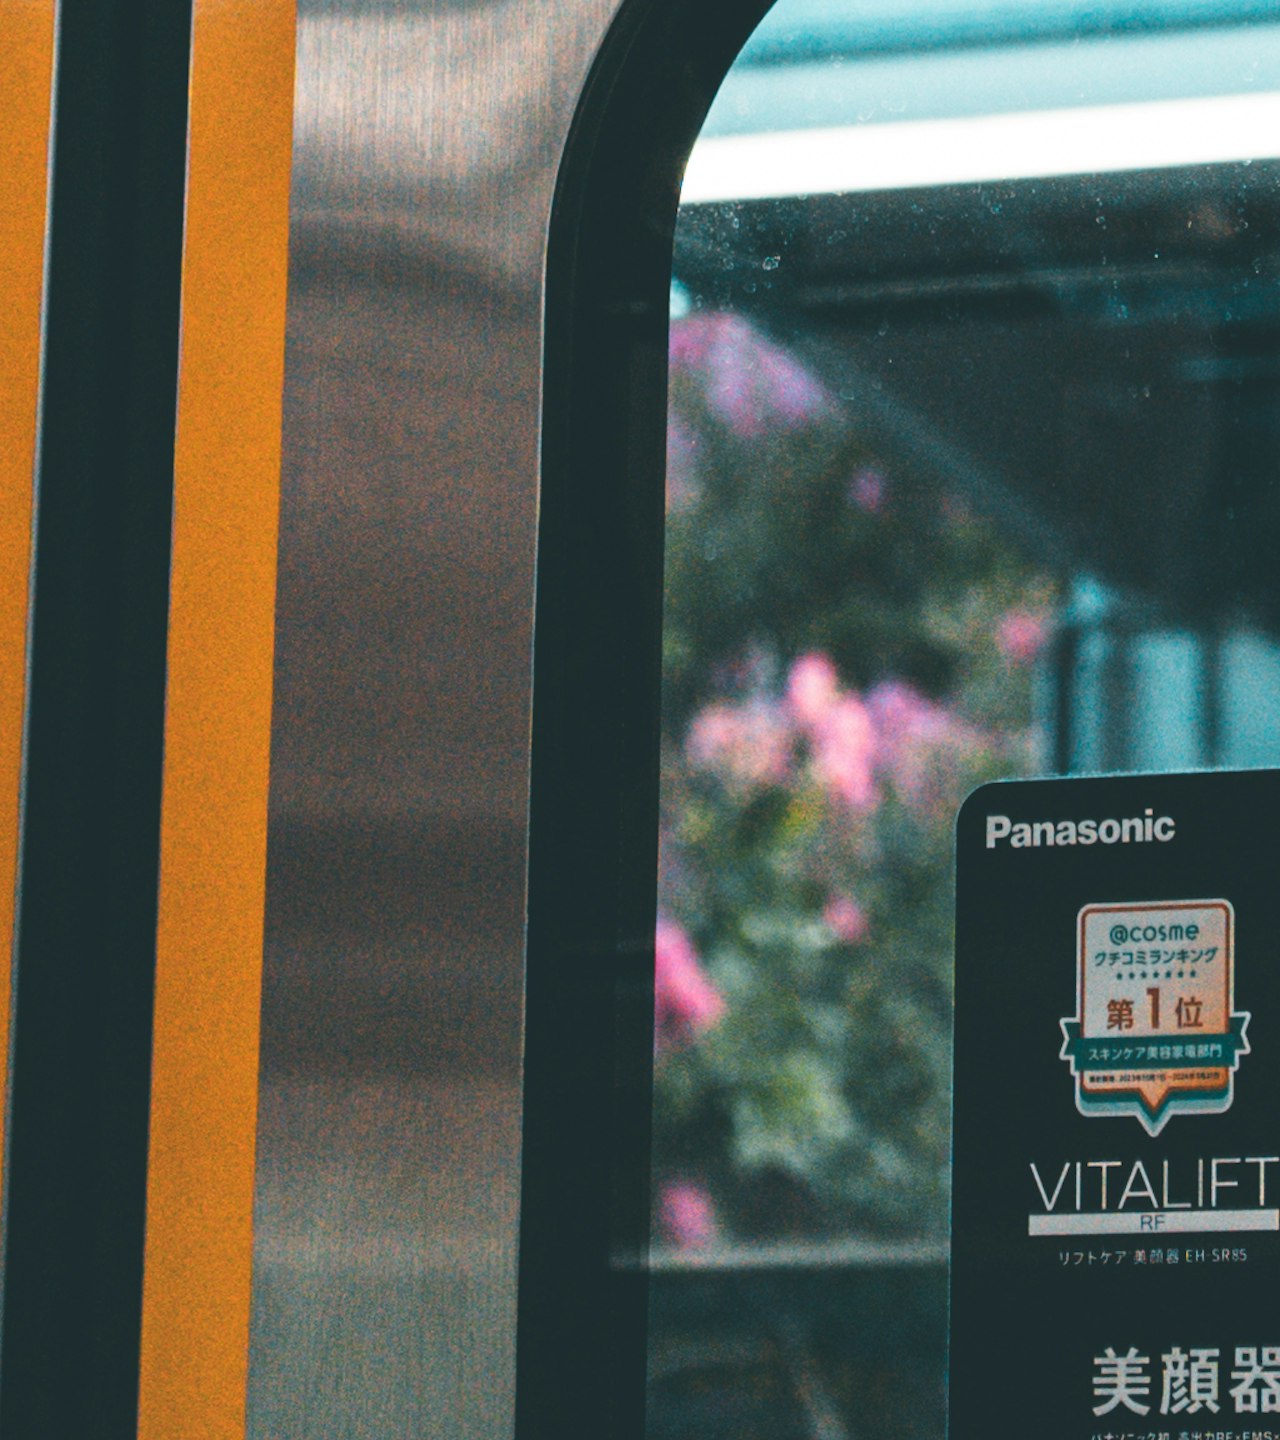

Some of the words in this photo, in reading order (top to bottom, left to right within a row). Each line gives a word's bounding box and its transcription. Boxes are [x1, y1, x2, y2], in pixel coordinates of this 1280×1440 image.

[985, 809, 1177, 849] Panasonic
[1109, 924, 1200, 946] @cosme
[1094, 946, 1219, 967] クチコミランキング
[1106, 986, 1204, 1031] 第1位
[1029, 1156, 1280, 1211] VITALIFT
[1140, 1214, 1166, 1230] RF
